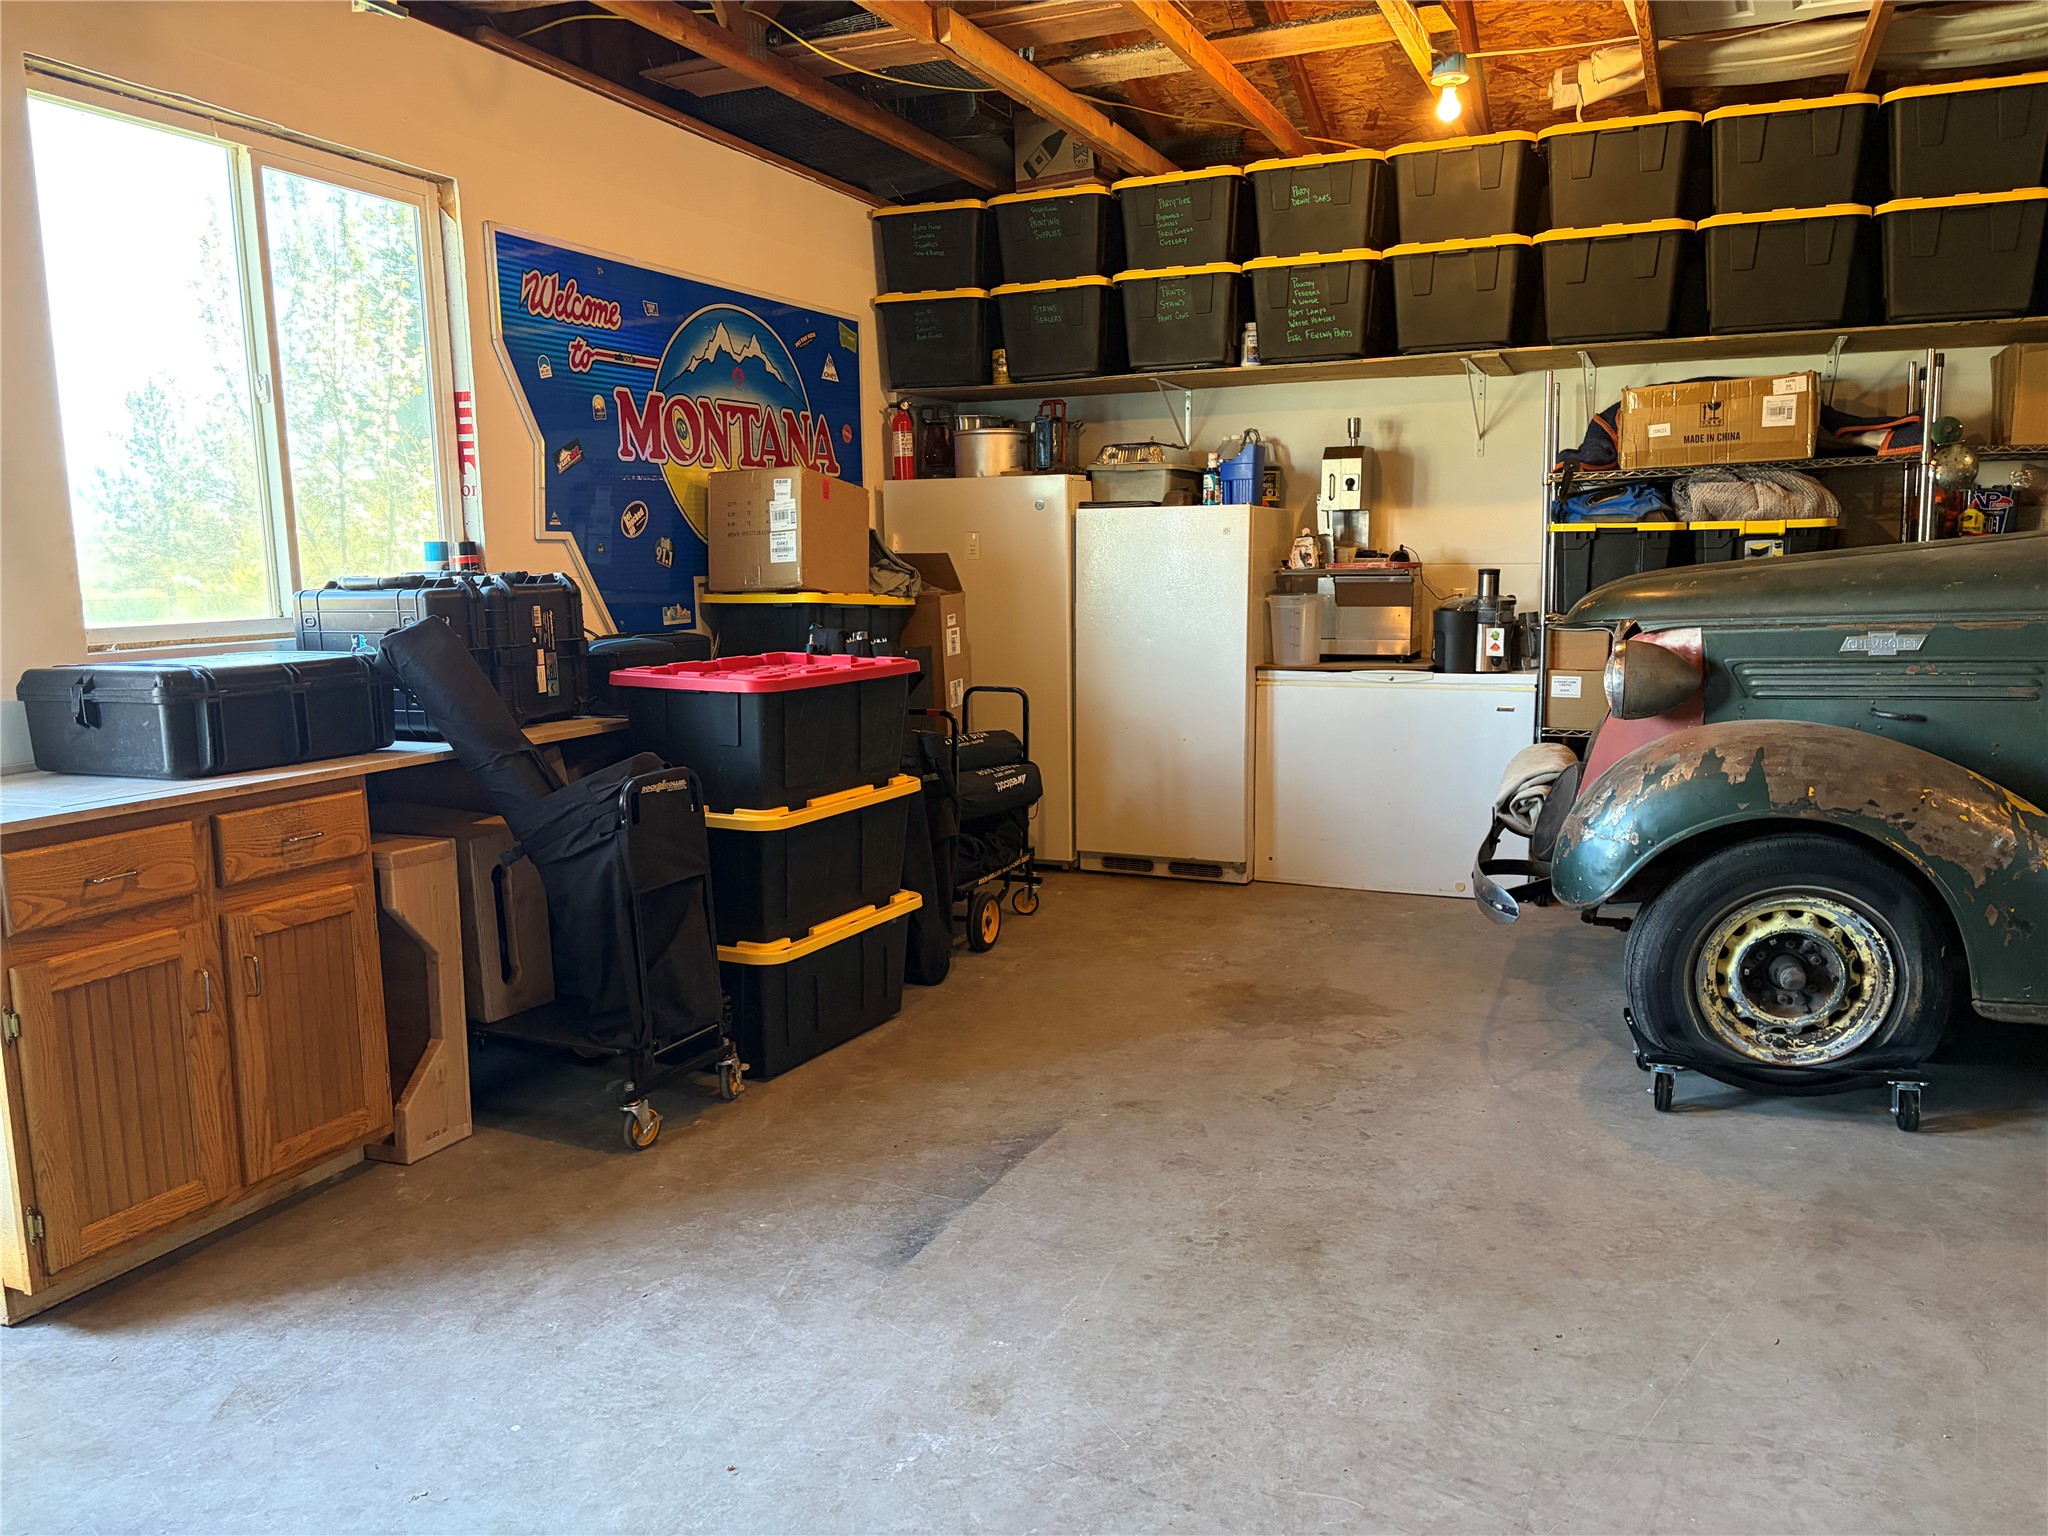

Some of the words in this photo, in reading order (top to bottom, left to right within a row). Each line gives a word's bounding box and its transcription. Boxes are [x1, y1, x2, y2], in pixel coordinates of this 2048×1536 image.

[1292, 186, 1310, 198] PARTY
[1314, 193, 1332, 203] JARS
[520, 268, 622, 331] Welcome
[1333, 327, 1353, 338] PARTS
[568, 336, 592, 374] to
[614, 386, 841, 477] MONTANA
[1683, 434, 1705, 444] MADE
[1706, 434, 1715, 442] IN
[1717, 431, 1741, 441] CHINA
[656, 546, 673, 566] 91.1
[1847, 638, 1918, 649] CHEVROLET
